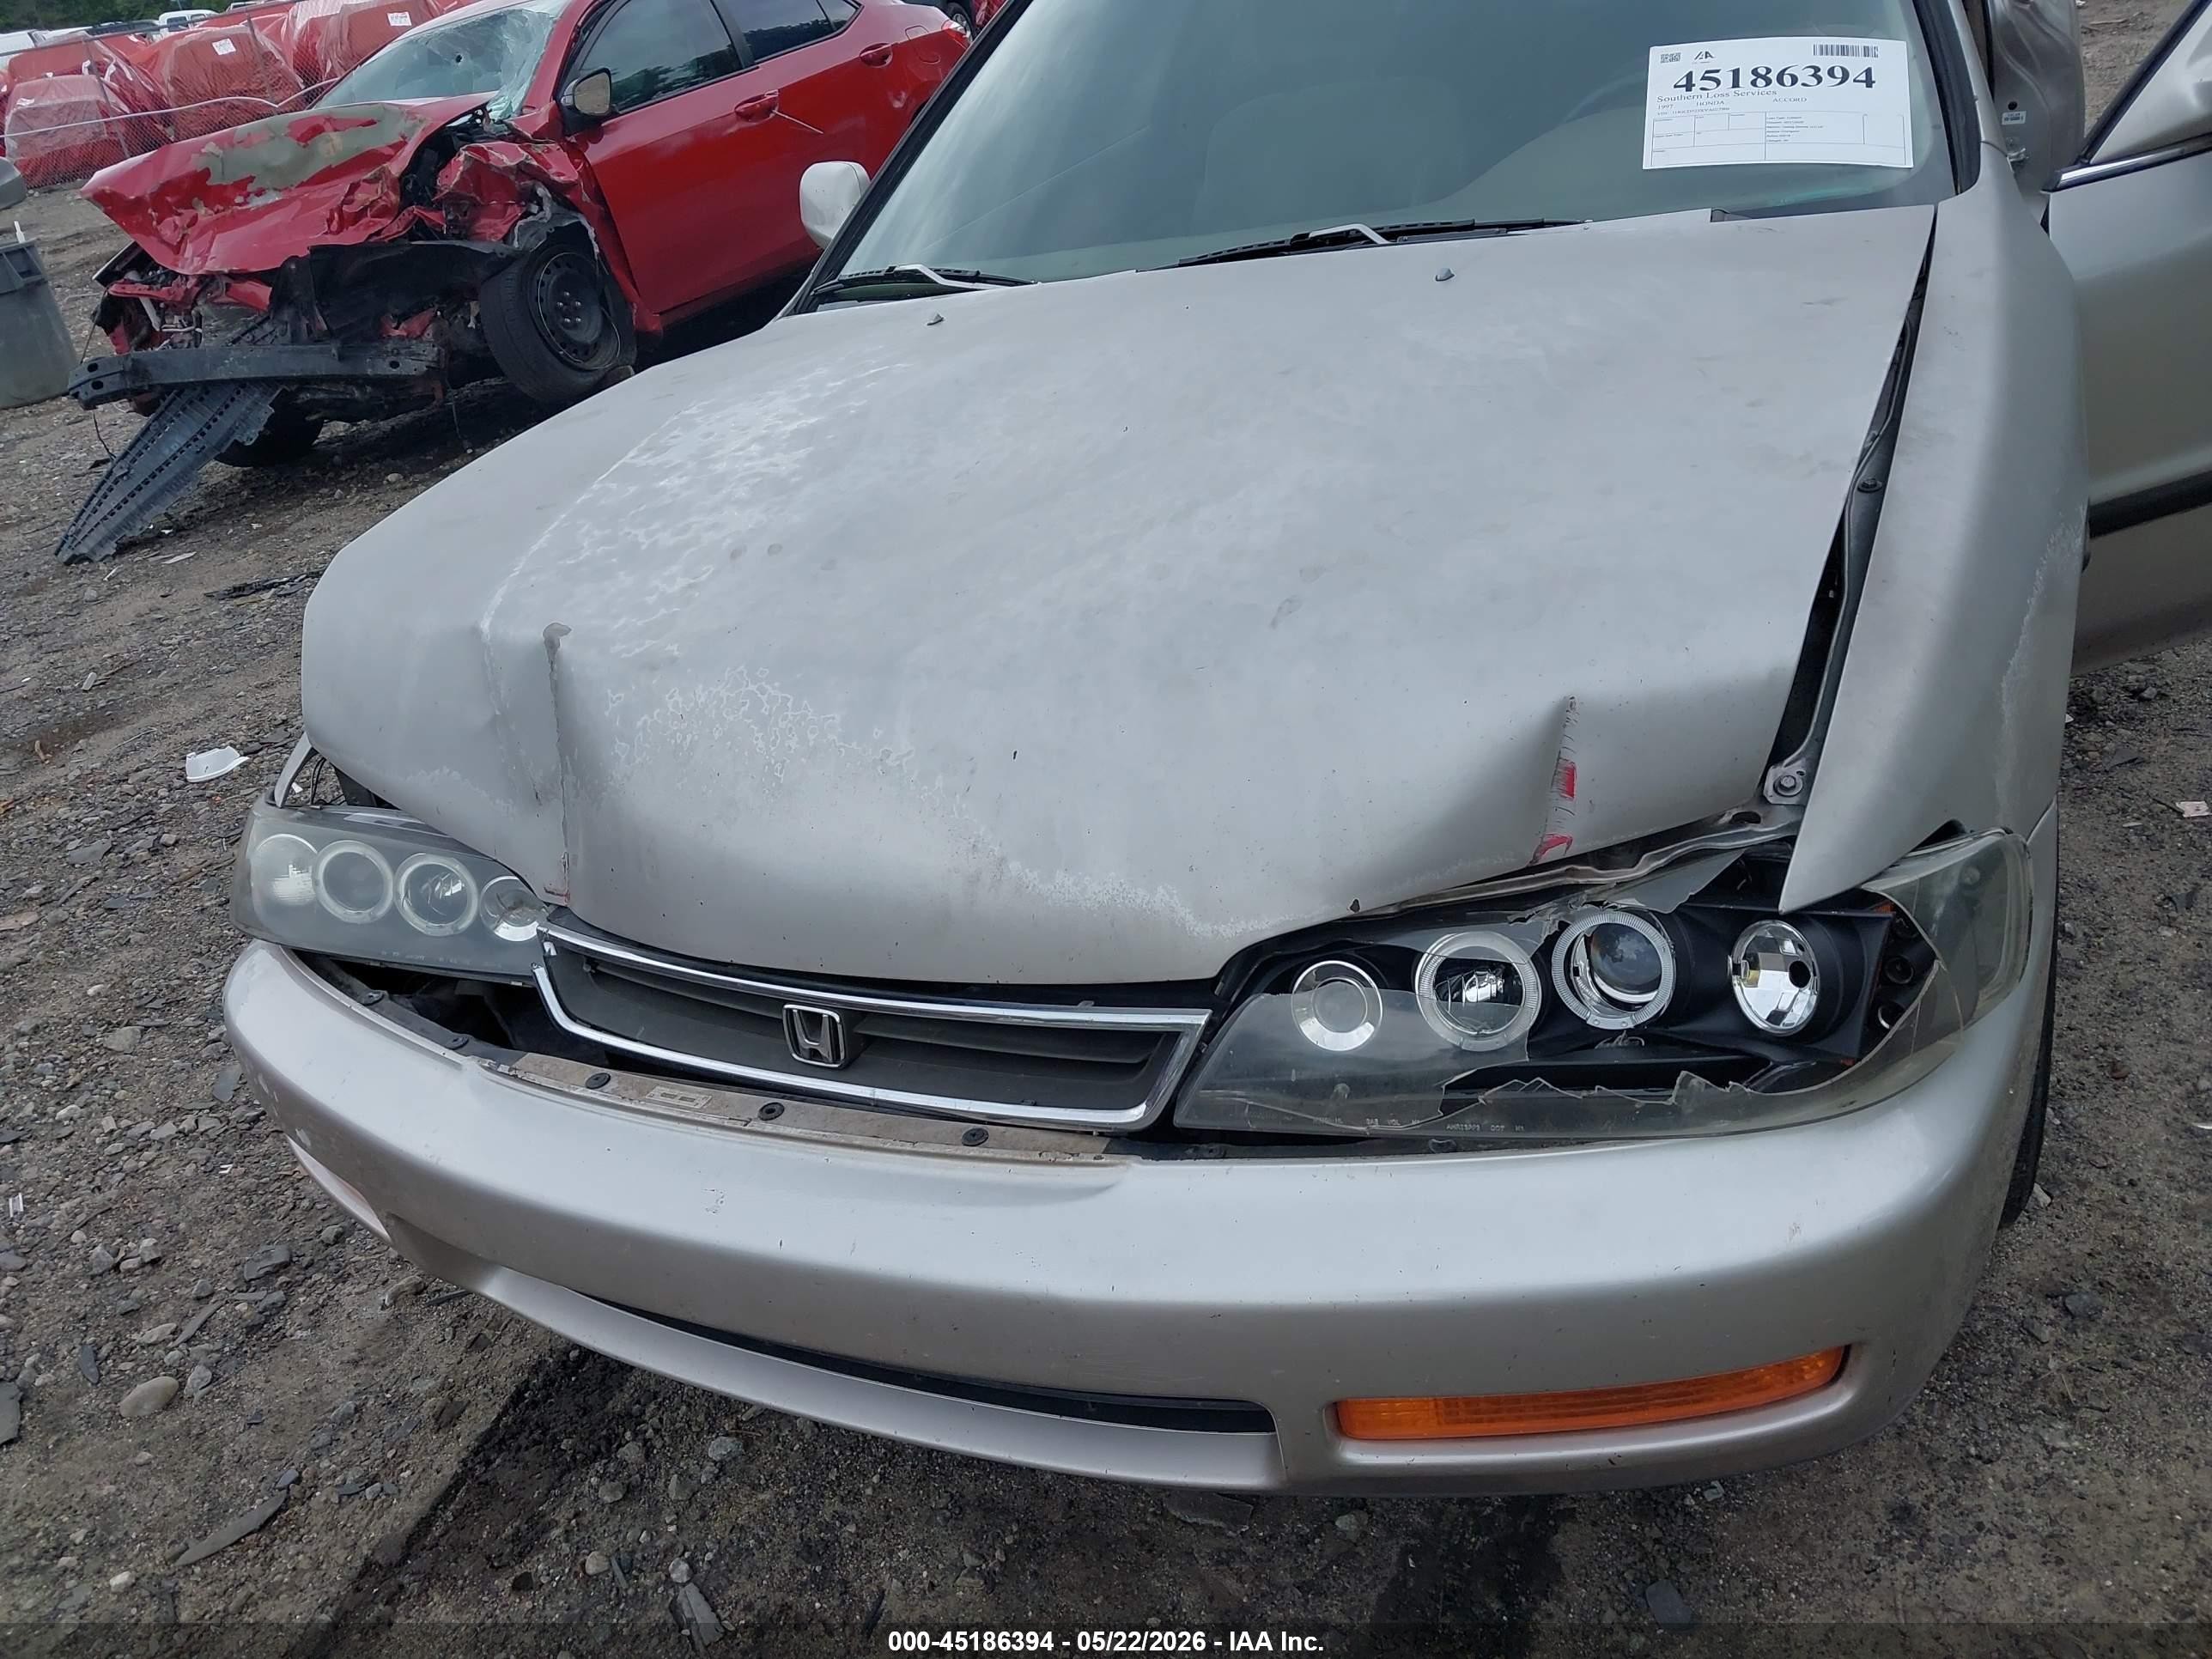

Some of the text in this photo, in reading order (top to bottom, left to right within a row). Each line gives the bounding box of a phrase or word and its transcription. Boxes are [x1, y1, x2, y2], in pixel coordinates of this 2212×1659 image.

[1674, 64, 1875, 93] 45186394
[1656, 88, 1777, 103] Southern Loss Services
